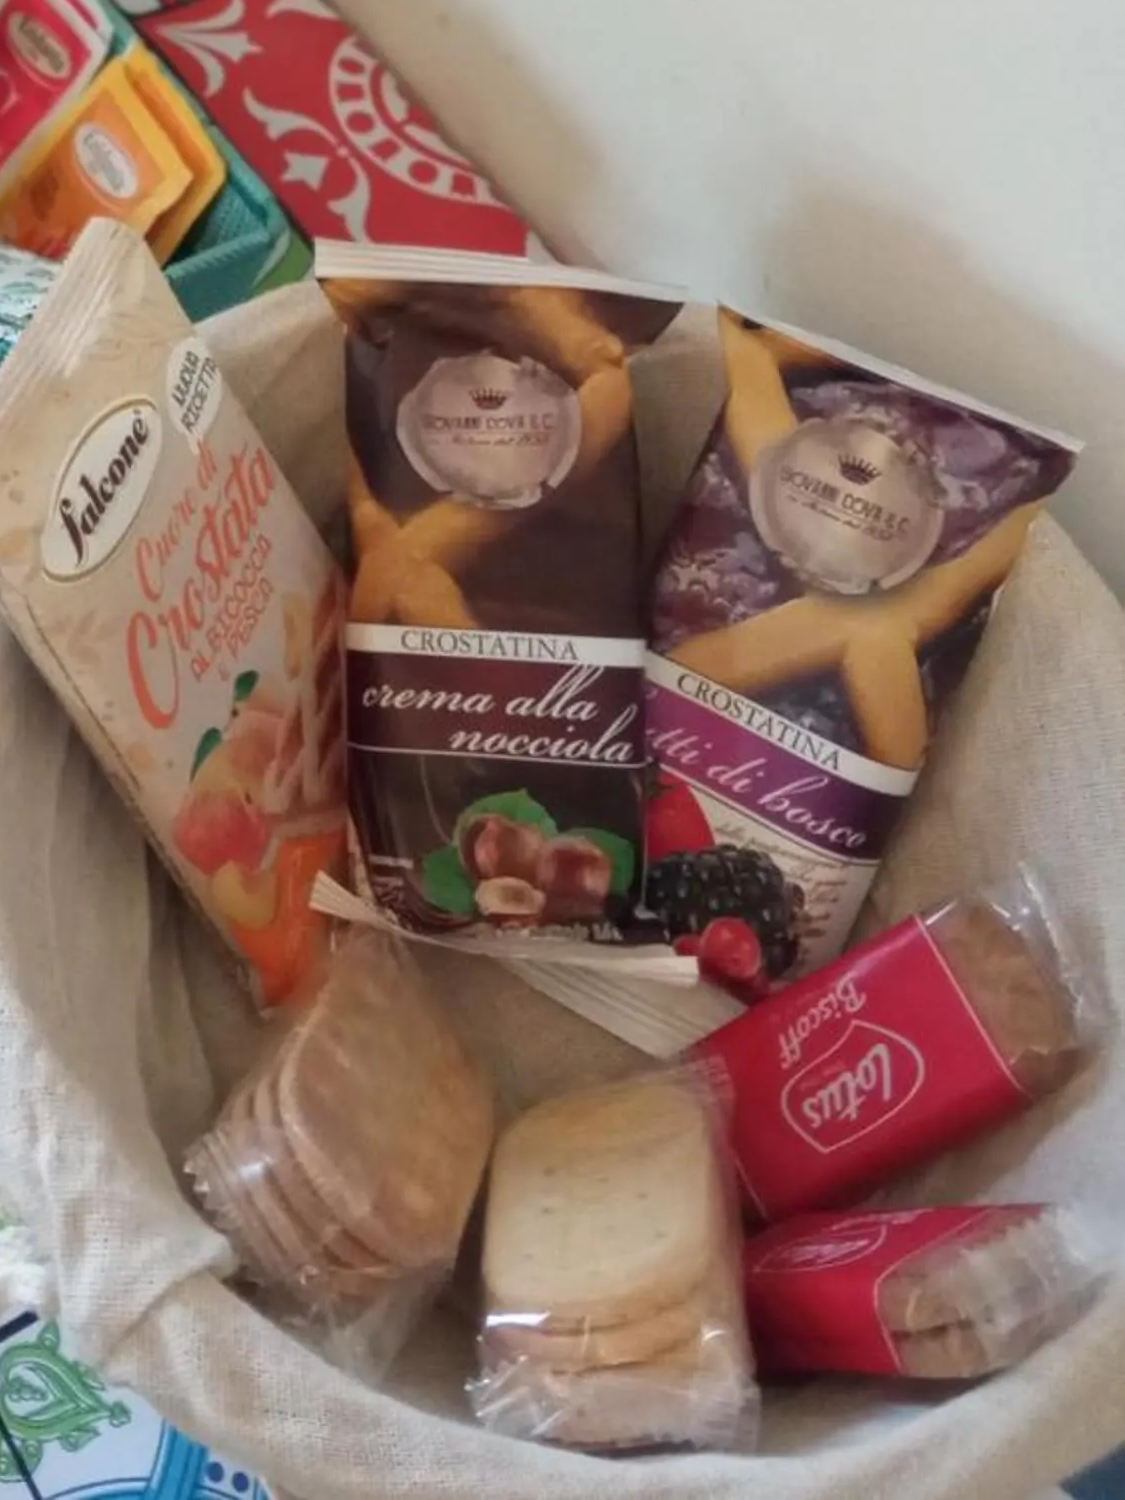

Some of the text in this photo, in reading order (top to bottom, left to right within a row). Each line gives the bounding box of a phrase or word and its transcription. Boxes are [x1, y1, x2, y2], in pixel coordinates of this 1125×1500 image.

[59, 417, 149, 565] falcone
[127, 441, 274, 729] Crostata
[400, 630, 579, 660] CROSTATINA
[362, 663, 604, 722] crema alla
[448, 703, 638, 762] nocciola
[676, 672, 842, 771] CROSTATINA
[706, 757, 768, 794] di
[756, 776, 868, 848] bosco
[779, 971, 867, 1070] Biscoff
[801, 1043, 892, 1128] Lotus
